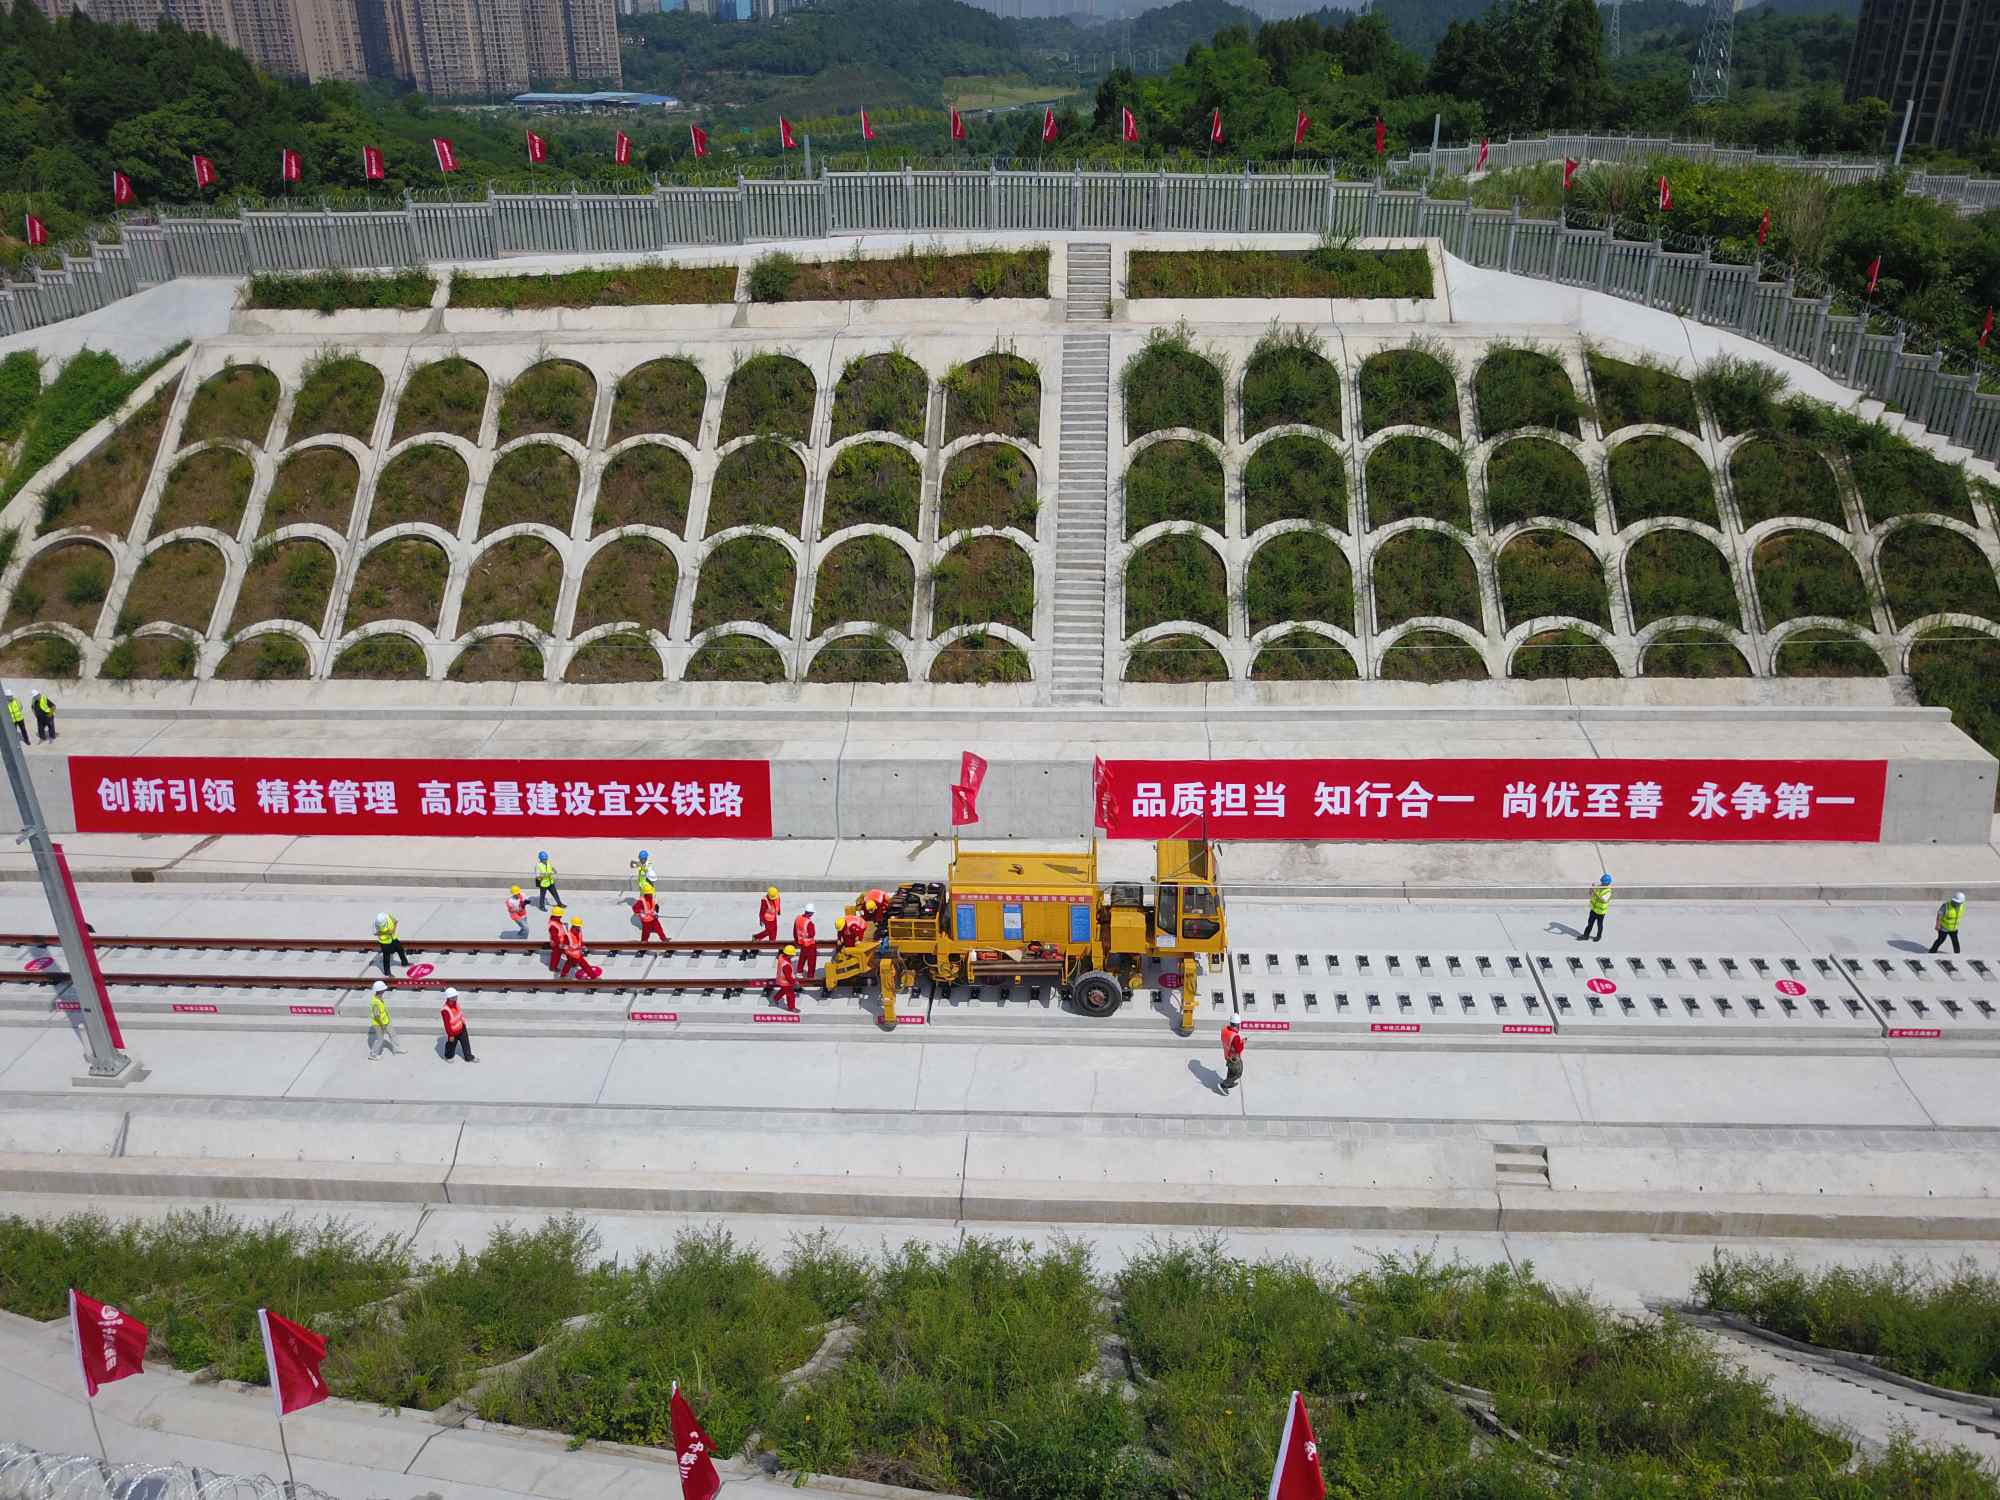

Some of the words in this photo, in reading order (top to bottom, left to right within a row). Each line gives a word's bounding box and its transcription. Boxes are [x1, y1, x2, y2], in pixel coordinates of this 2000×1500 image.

[97, 778, 236, 813] 创新引领
[256, 779, 398, 815] 精益管理
[418, 780, 744, 817] 高质量建设宜兴铁路
[1132, 781, 1286, 818] 品质担当
[1314, 781, 1475, 818] 知行合一
[1502, 781, 1663, 819] 尚优至善
[1688, 781, 1855, 820] 永争第一
